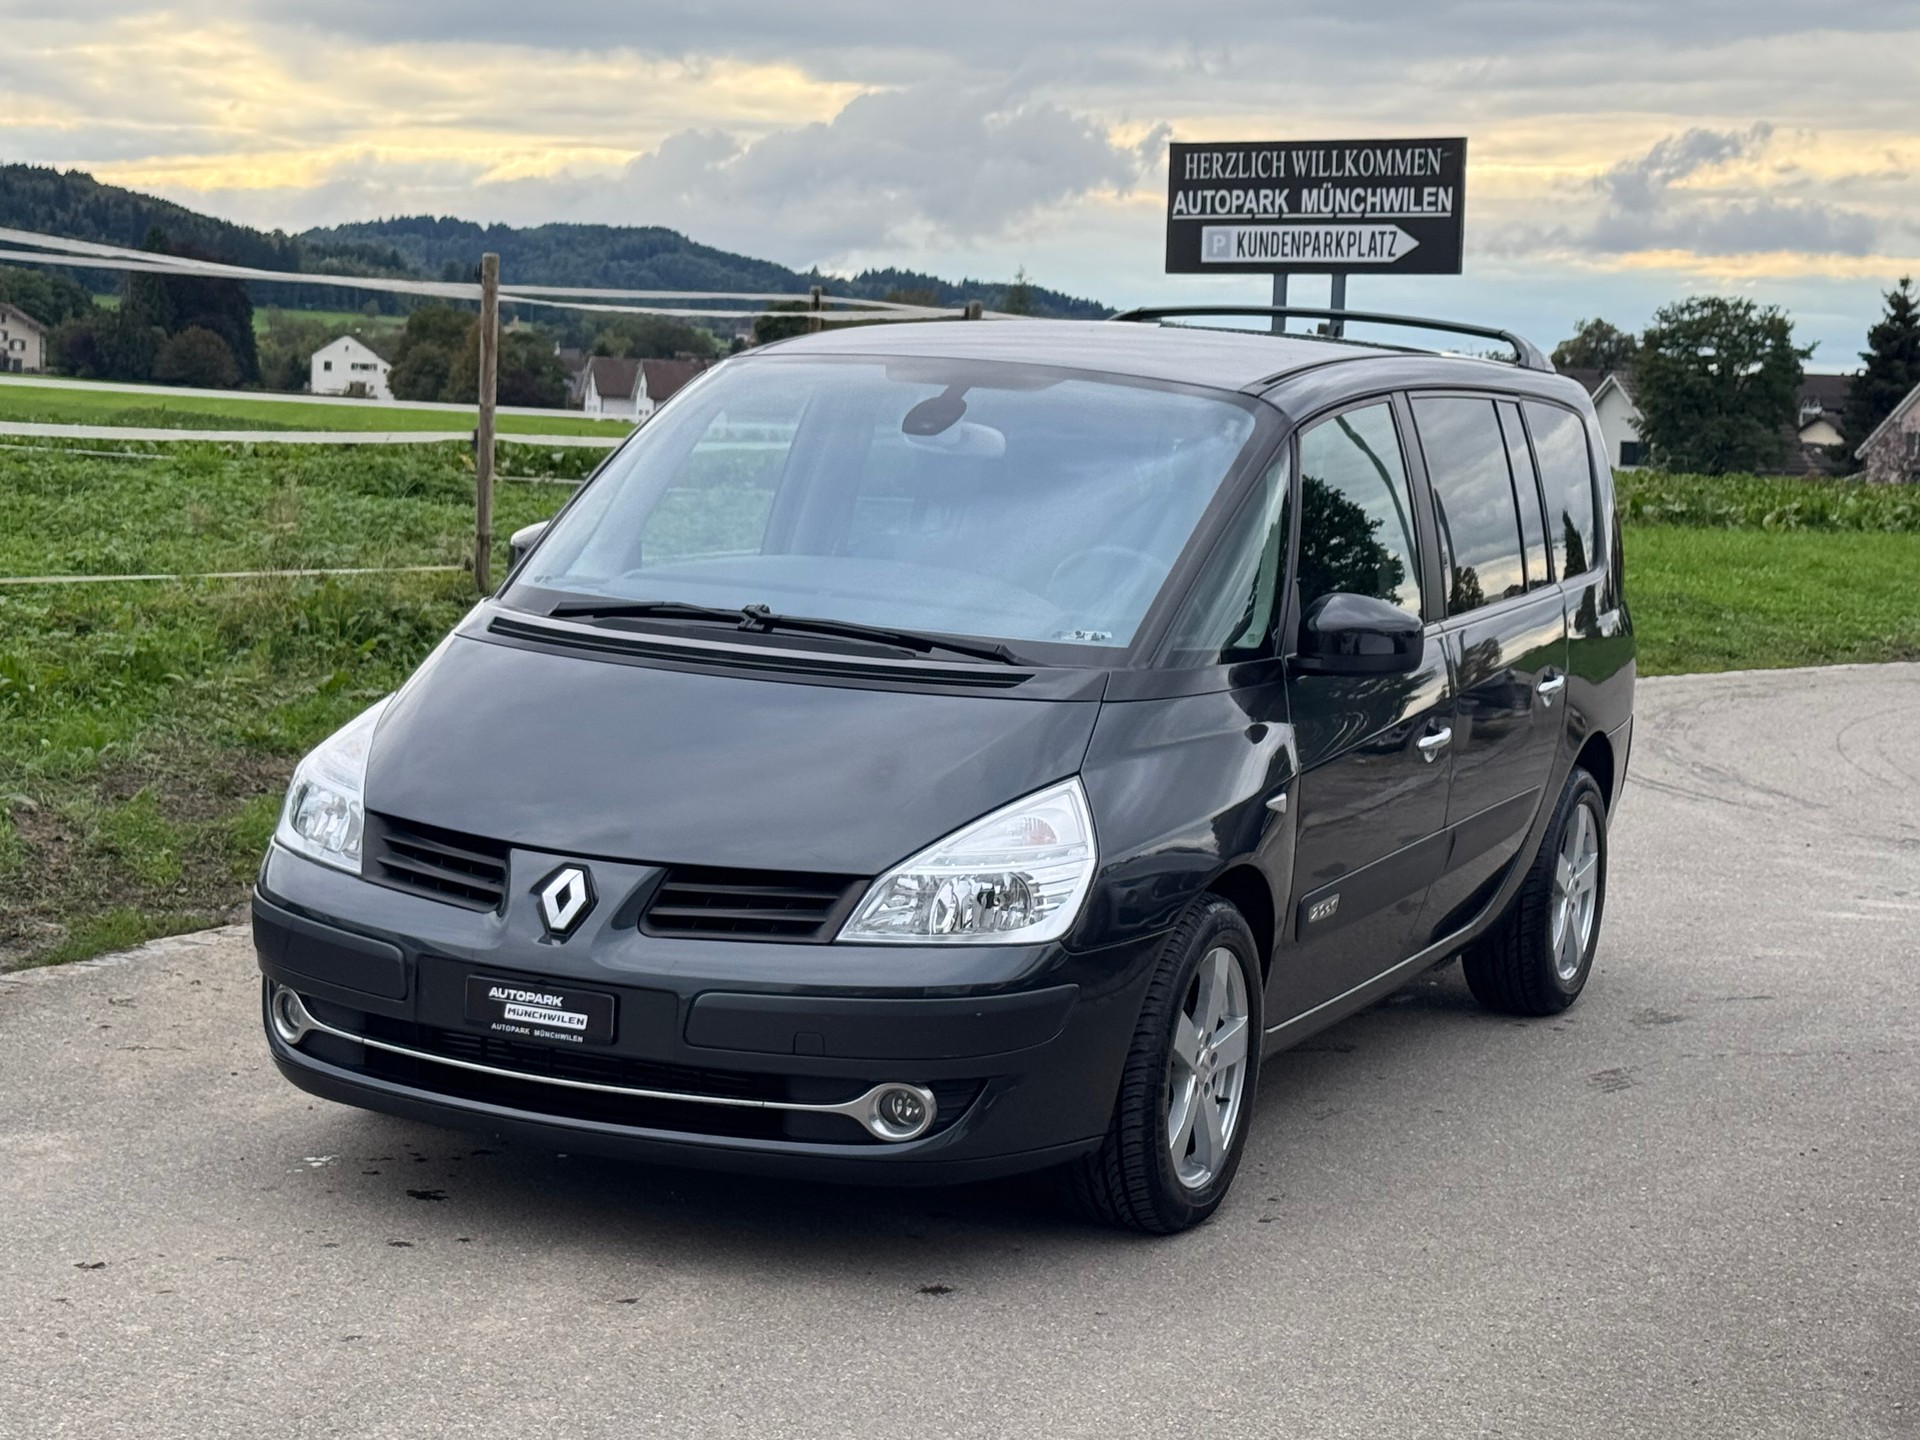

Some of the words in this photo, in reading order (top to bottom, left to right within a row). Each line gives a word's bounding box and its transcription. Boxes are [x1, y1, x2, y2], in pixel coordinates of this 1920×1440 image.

[1184, 150, 1286, 180] HERZLICH
[1291, 147, 1442, 178] WILLKOMMEN
[1172, 188, 1290, 215] AUTOPARK
[1300, 181, 1454, 214] MÜNCHWILEN
[1211, 233, 1227, 255] P
[1236, 230, 1398, 258] KUNDENPARKPLATZ
[488, 986, 564, 1007] AUTOPARK
[507, 1006, 585, 1026] MÜNCHWILEN
[491, 1022, 531, 1036] AUTOPARK
[533, 1028, 584, 1043] MÜNCHWILEN
